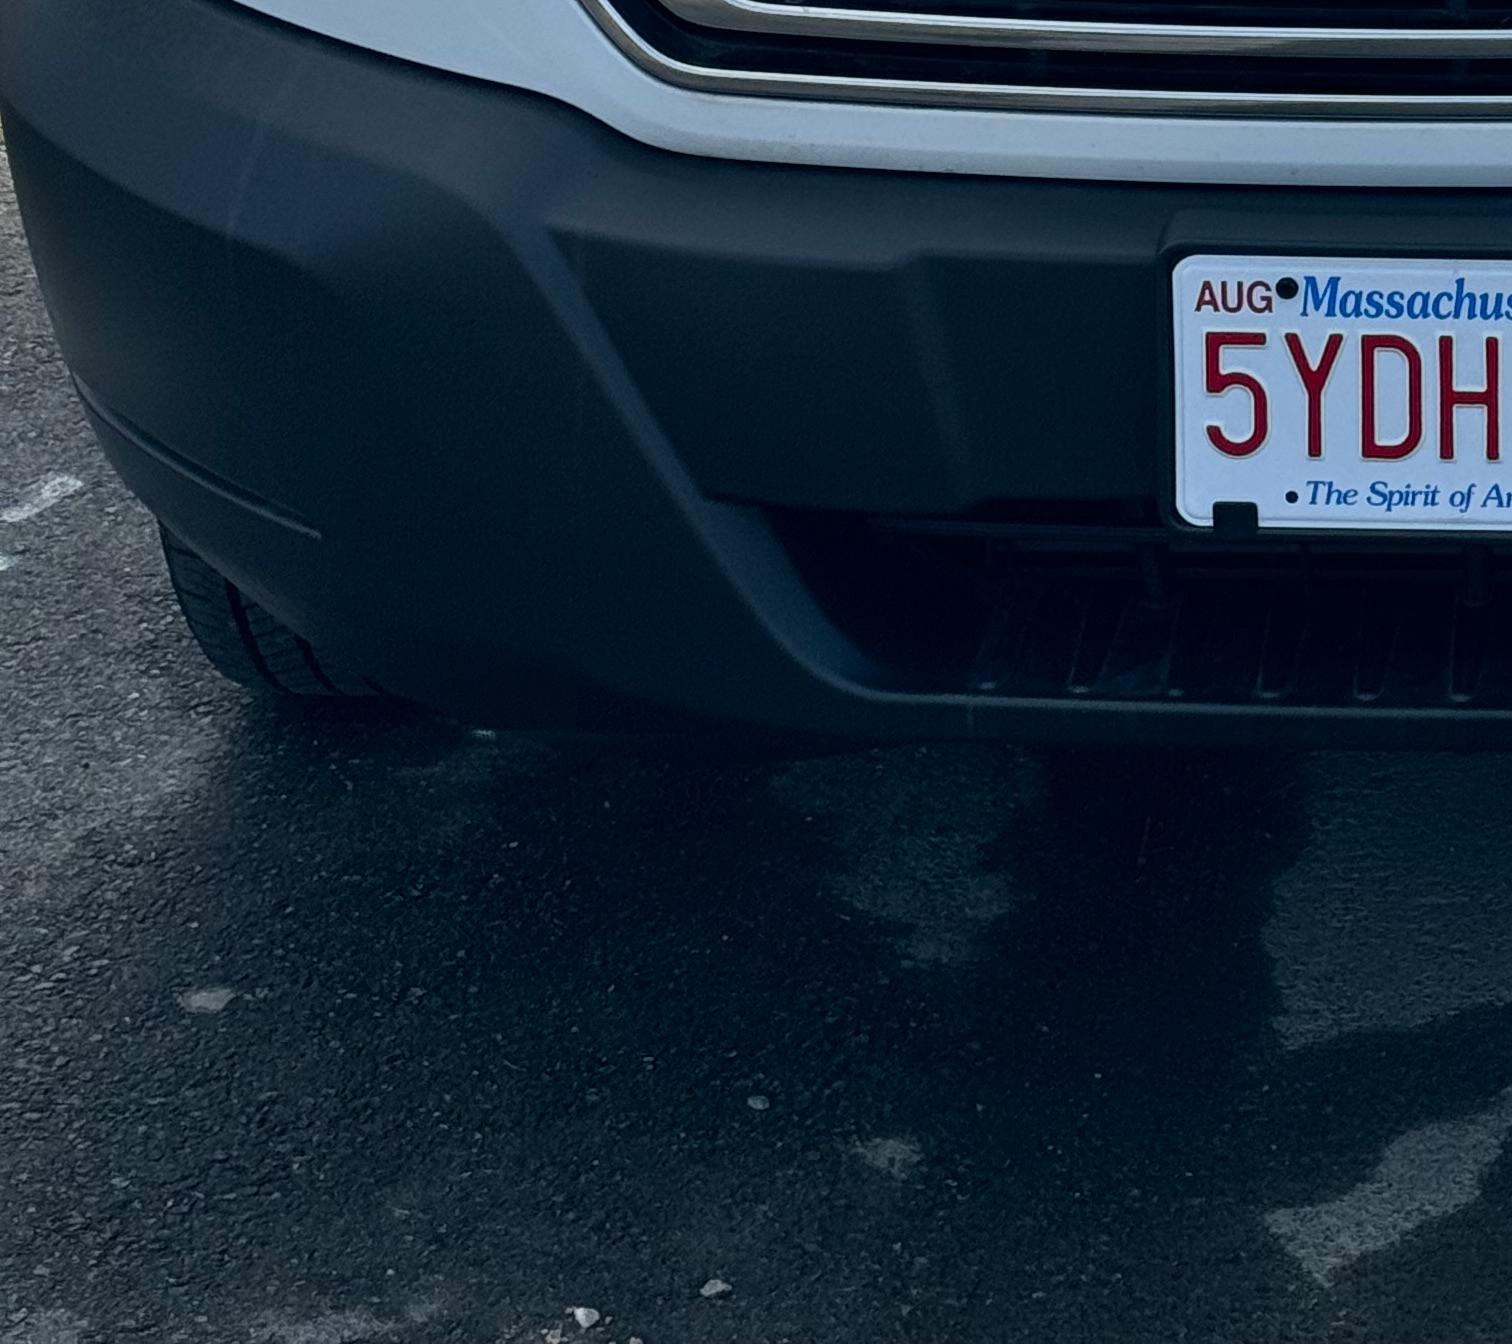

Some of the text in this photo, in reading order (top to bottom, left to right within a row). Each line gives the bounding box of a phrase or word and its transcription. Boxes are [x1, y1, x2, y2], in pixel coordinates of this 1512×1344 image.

[1193, 280, 1274, 314] AUG
[1205, 331, 1500, 461] 5YDH
[1306, 480, 1359, 508] The
[1366, 480, 1440, 513] Spirit
[1447, 483, 1478, 514] of
